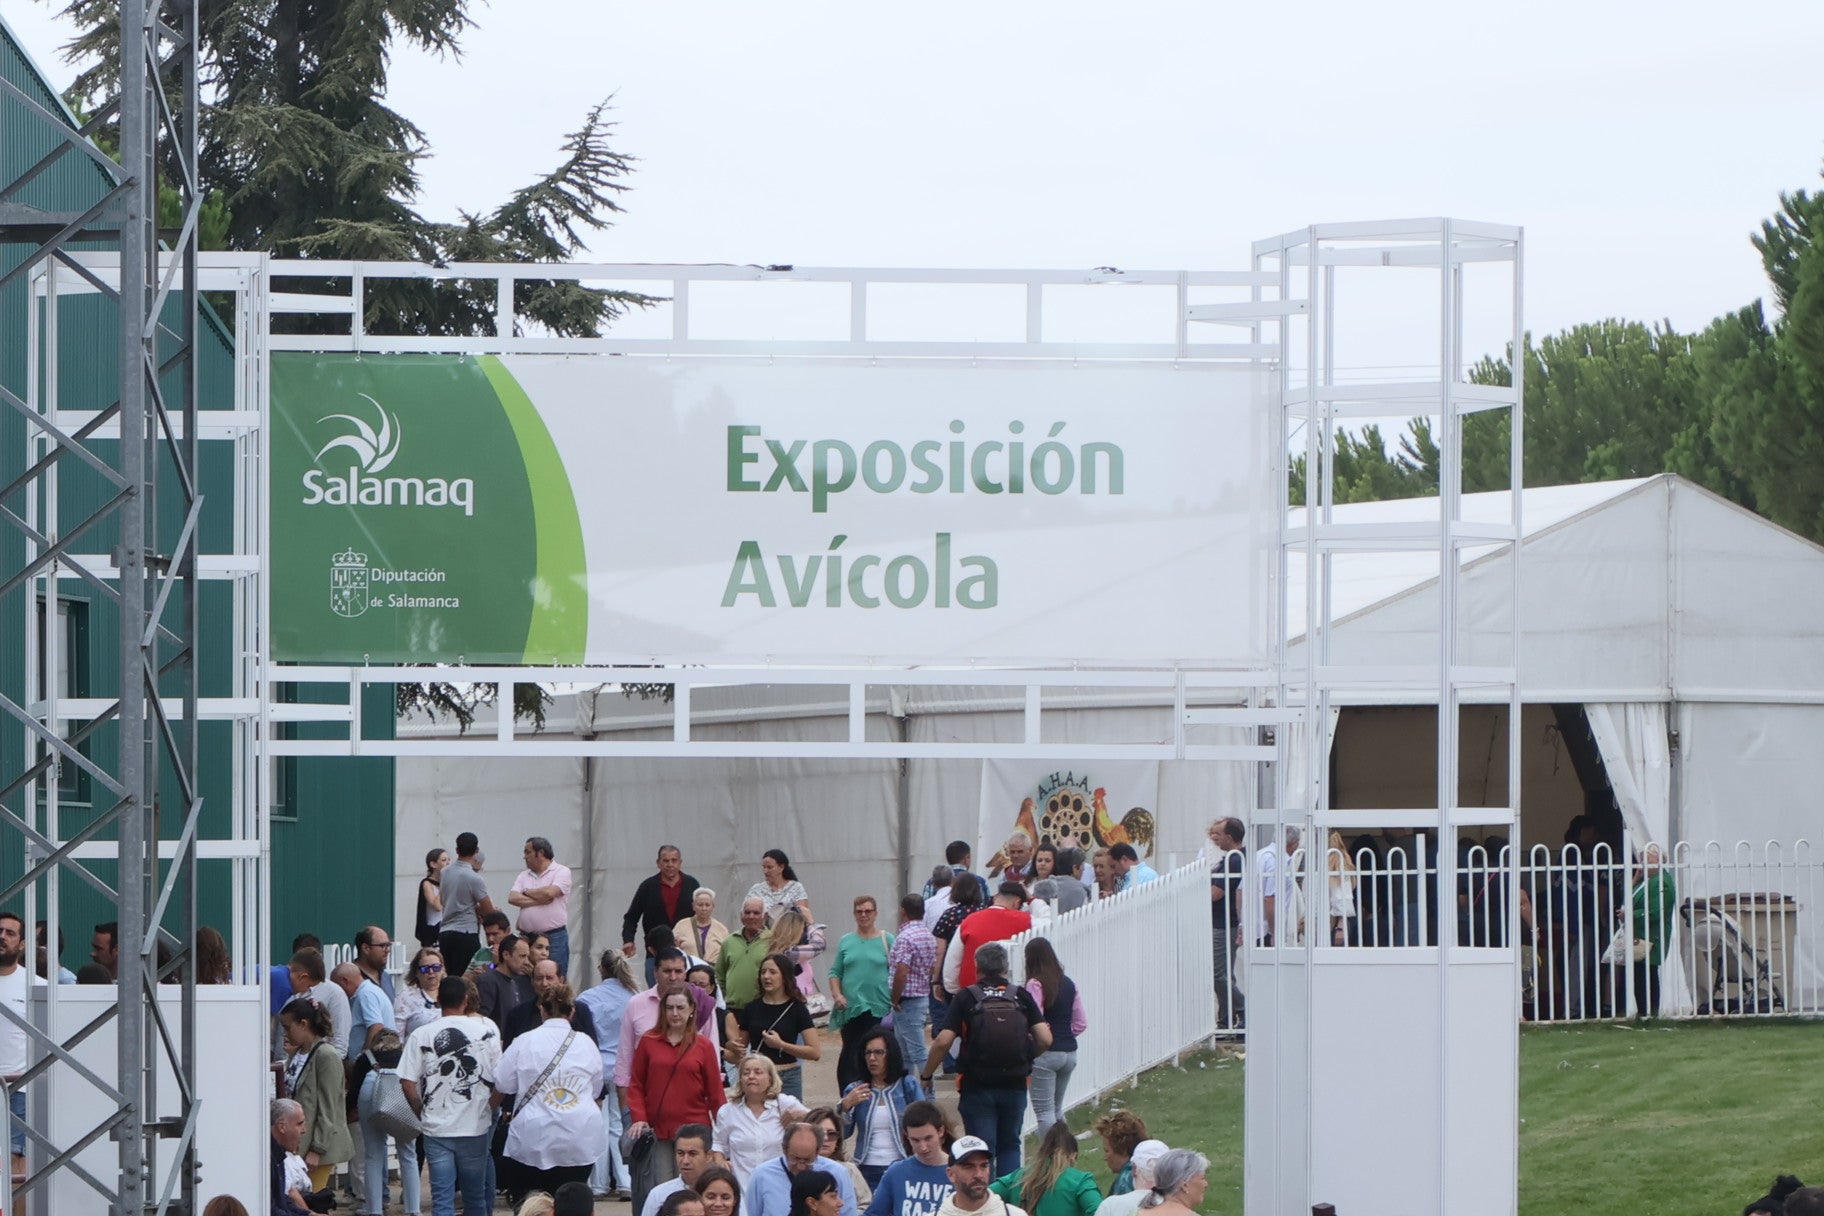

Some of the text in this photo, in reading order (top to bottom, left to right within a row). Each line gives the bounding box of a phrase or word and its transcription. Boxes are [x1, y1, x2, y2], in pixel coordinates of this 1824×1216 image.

[302, 466, 474, 516] Salamaq
[726, 419, 1125, 513] Exposición
[371, 568, 446, 585] Diputación
[720, 532, 999, 610] Avícola
[370, 594, 460, 608] de Salamanca
